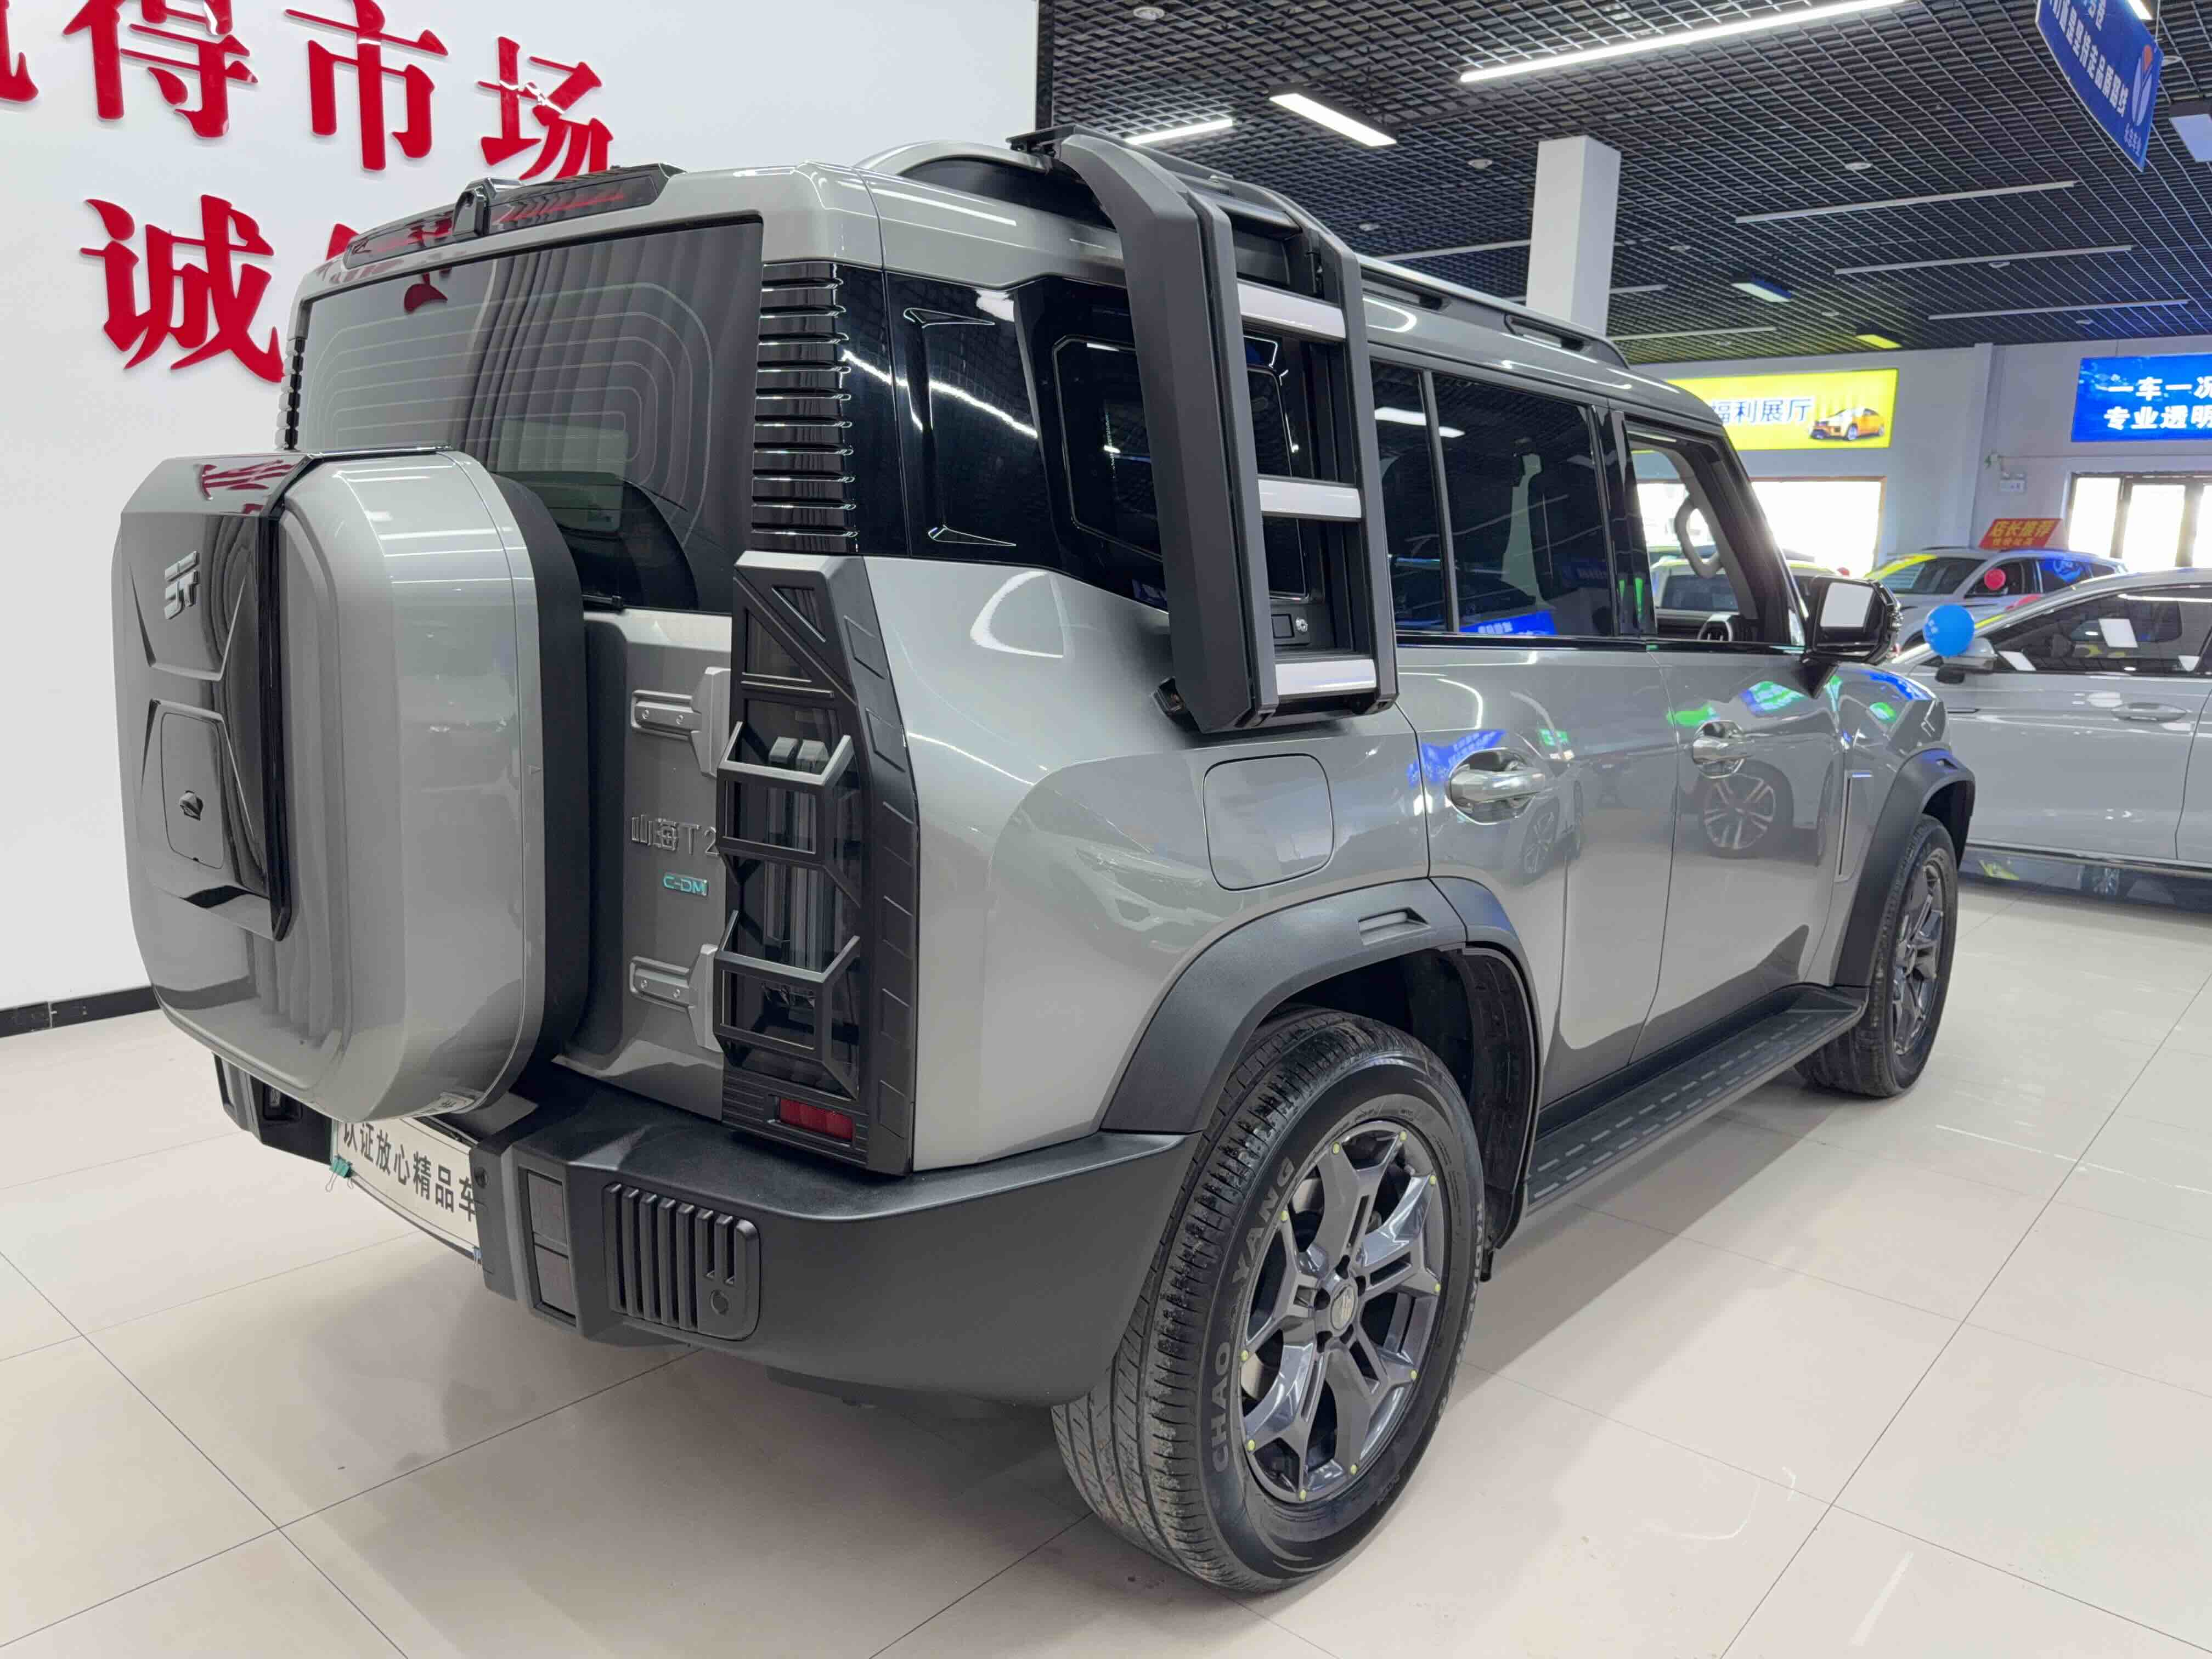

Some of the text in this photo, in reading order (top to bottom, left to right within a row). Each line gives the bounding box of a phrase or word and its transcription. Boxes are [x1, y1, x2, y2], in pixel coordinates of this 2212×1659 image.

[0, 0, 614, 180] 得市场
[80, 194, 360, 383] 诚
[2103, 405, 2212, 430] 专业透明
[663, 875, 708, 896] C-DM
[1211, 1156, 1295, 1472] CHAO YANG
